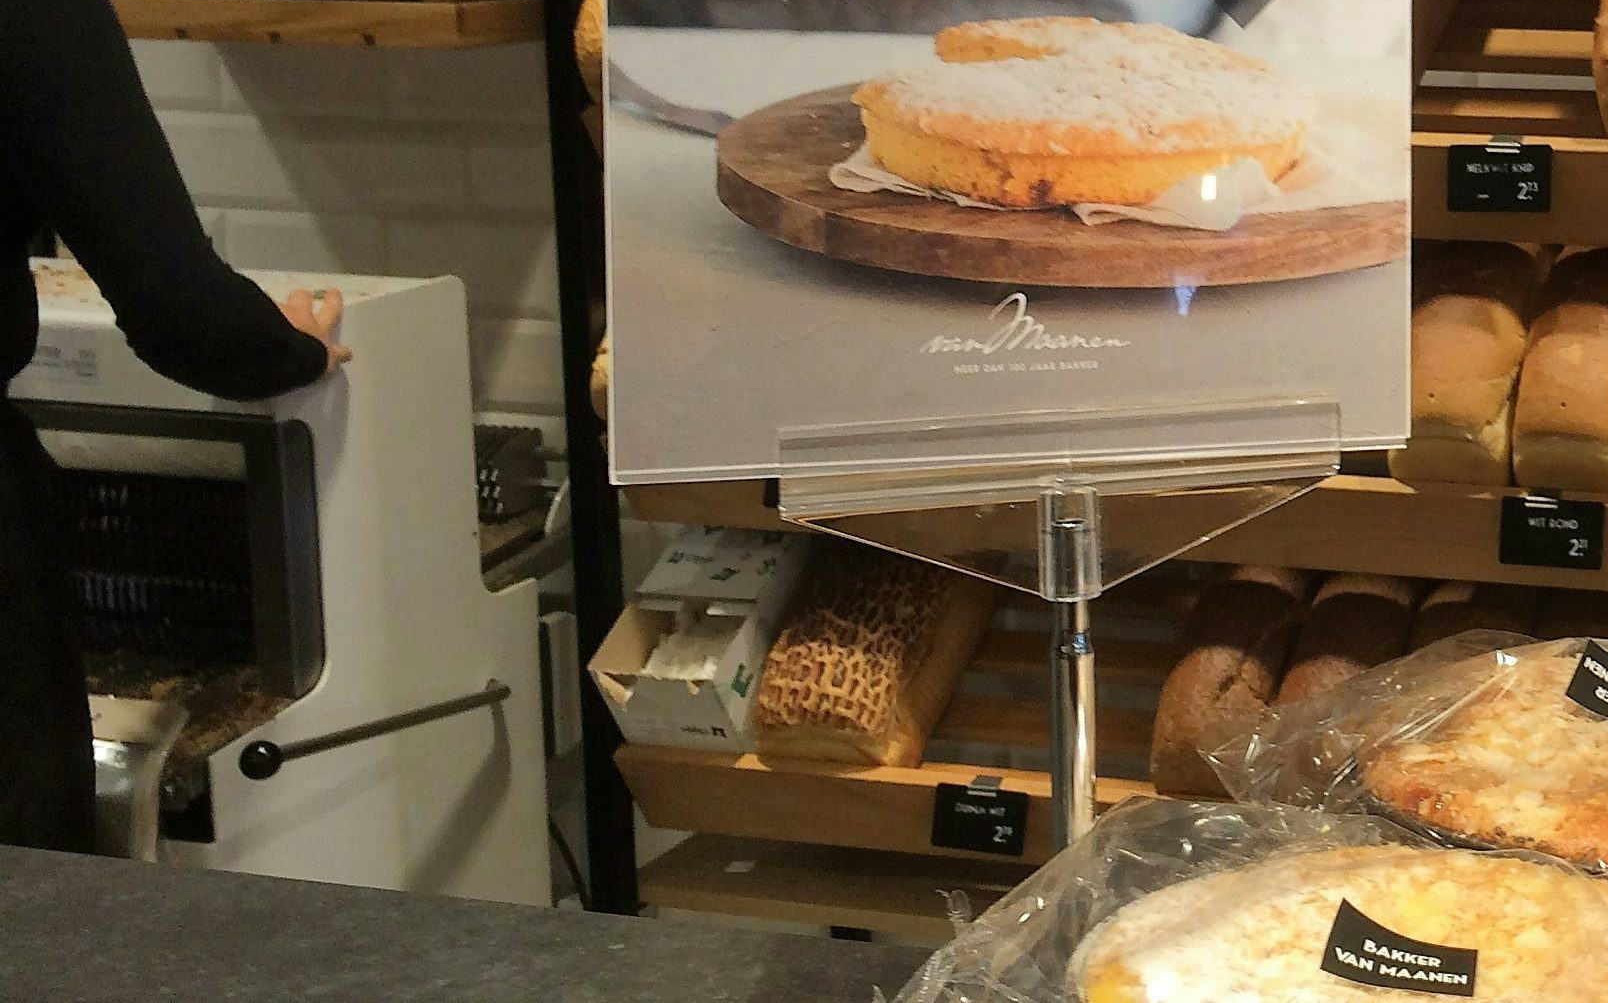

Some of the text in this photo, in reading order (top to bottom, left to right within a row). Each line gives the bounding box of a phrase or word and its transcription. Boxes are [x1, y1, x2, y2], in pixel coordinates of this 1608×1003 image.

[1334, 946, 1469, 986] VAN MAANEN
[1362, 938, 1442, 968] BAKKER
